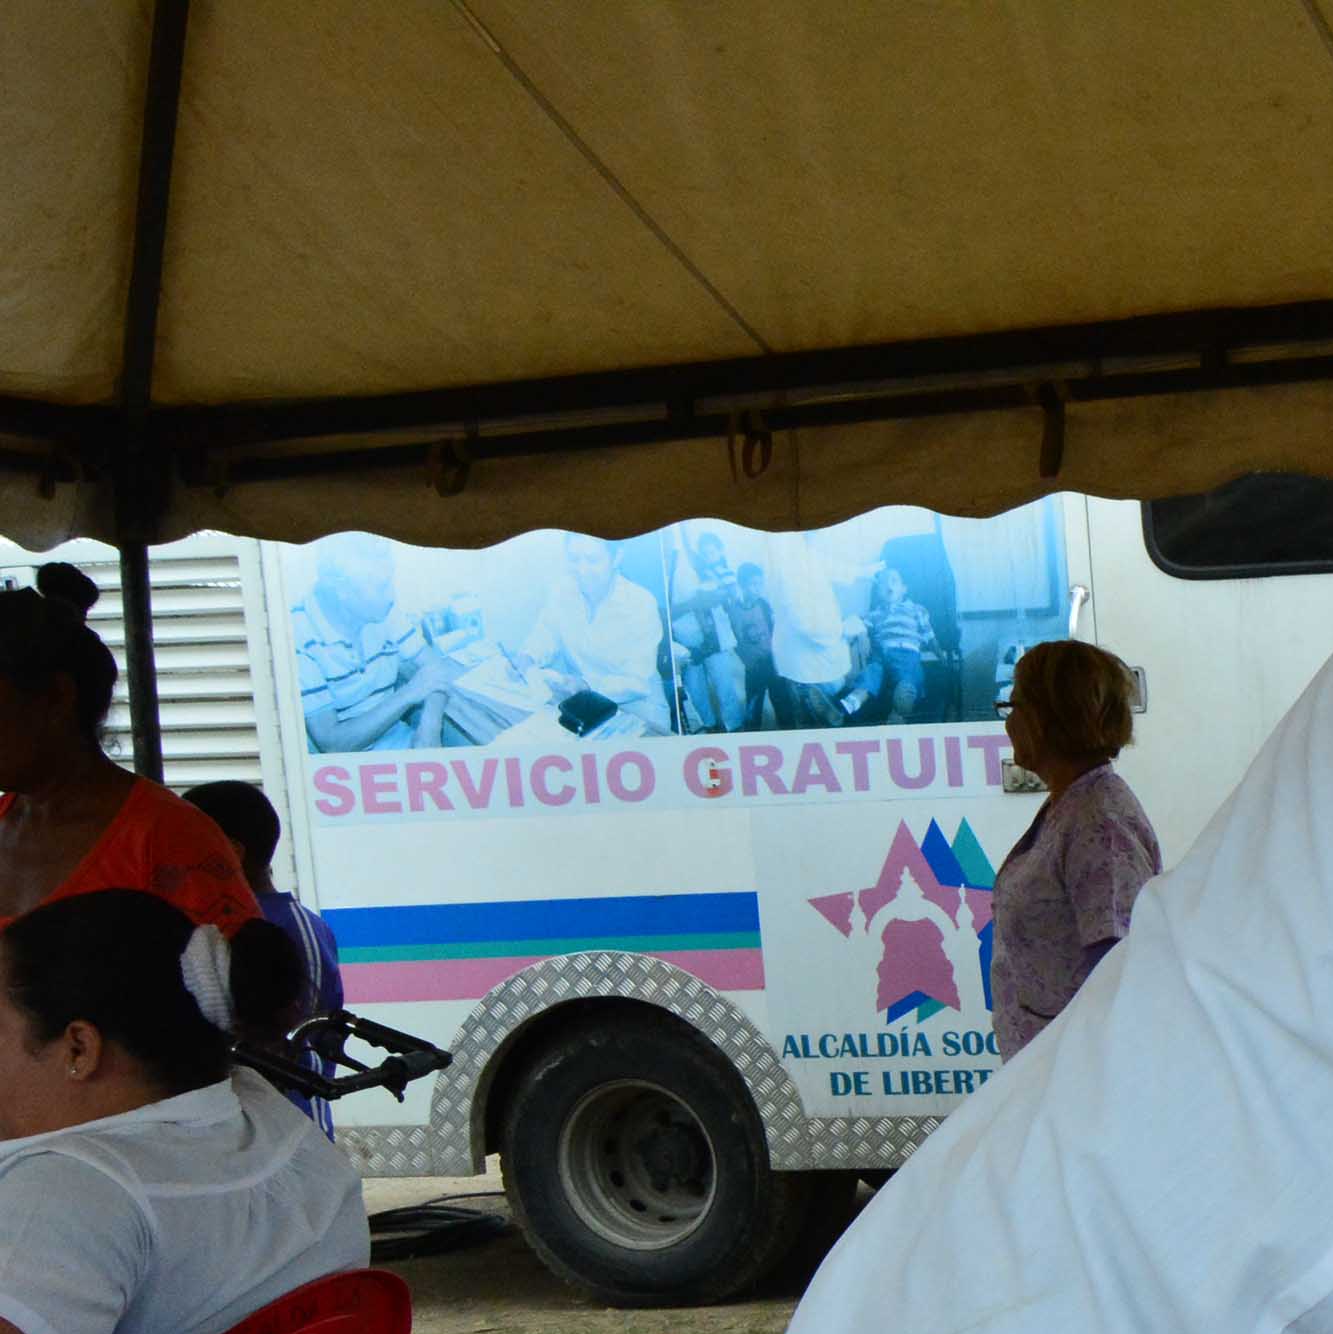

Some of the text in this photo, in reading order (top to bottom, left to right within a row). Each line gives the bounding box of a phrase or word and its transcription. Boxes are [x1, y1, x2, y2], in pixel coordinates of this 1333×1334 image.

[313, 751, 656, 816] SERVICIO
[782, 1026, 933, 1059] ALCALDÍA
[829, 1071, 873, 1096] DE
